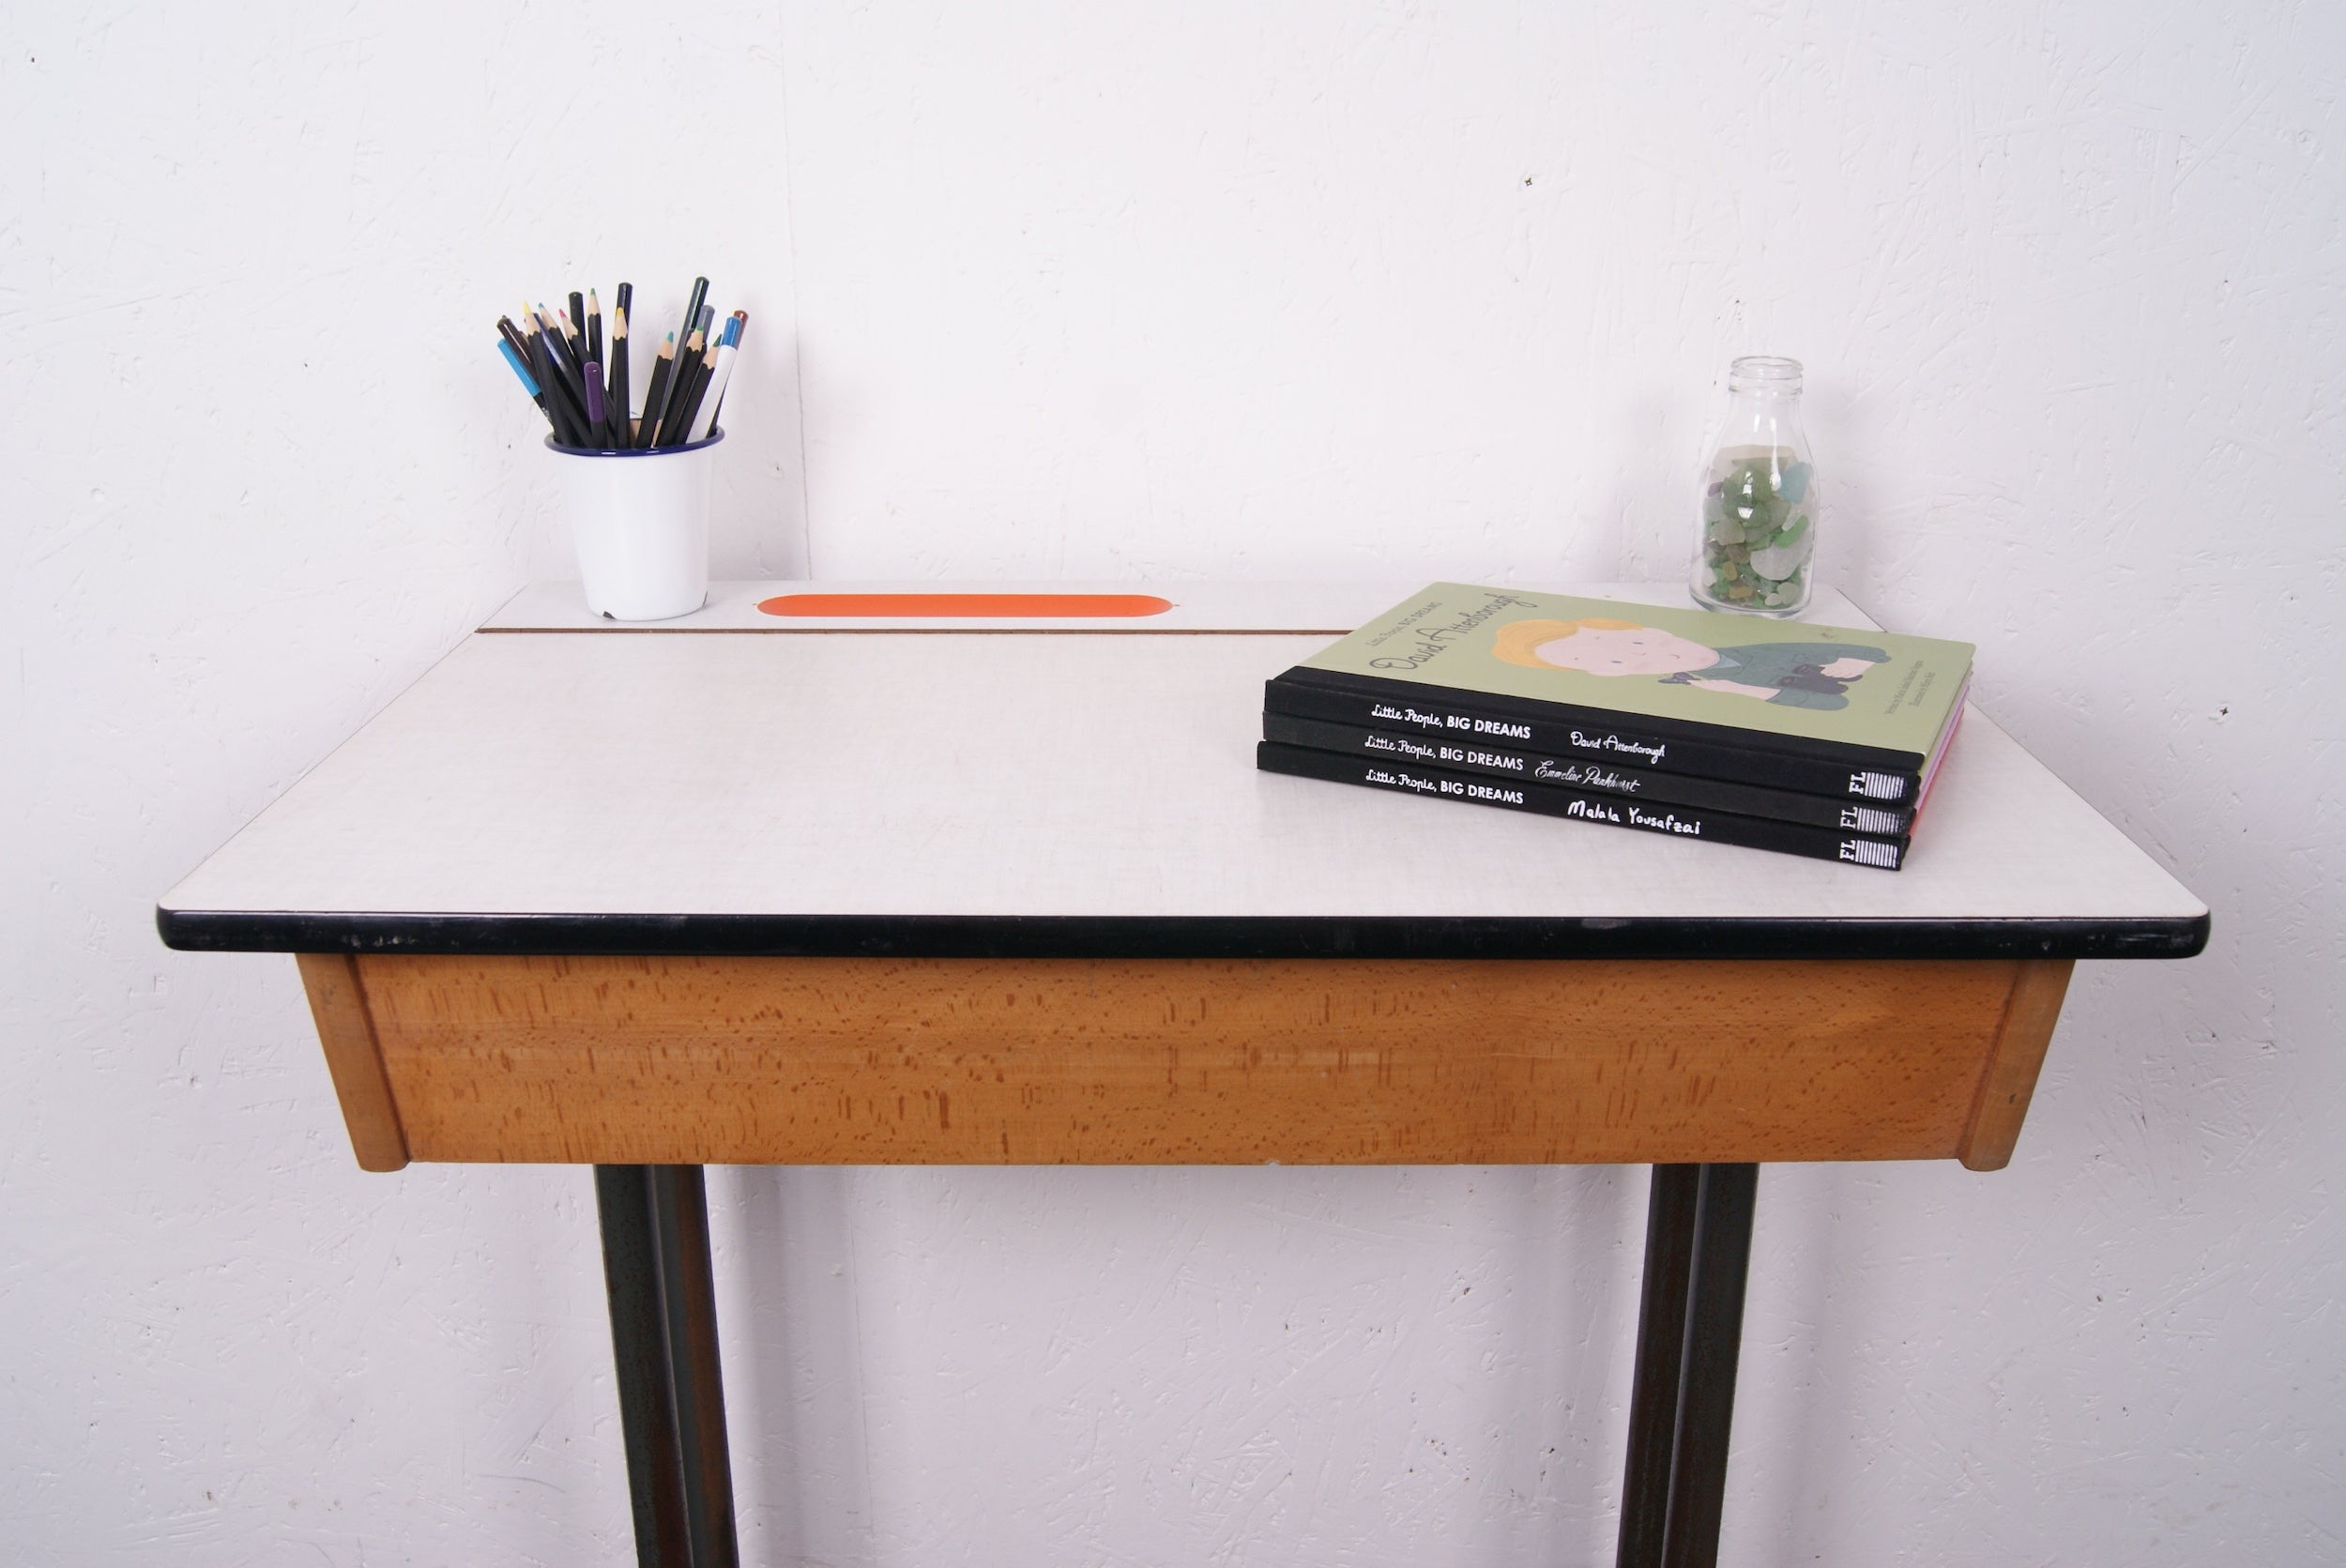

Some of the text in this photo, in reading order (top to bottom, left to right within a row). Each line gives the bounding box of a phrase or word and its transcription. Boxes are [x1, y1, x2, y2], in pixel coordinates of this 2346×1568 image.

[1369, 592, 1538, 670] David Attenborough
[1371, 704, 1531, 739] Little People, BIG DREAMS
[1364, 735, 1524, 771] Little People, BIG DREAMS
[1570, 731, 1666, 765] David Attenborough
[1365, 769, 1524, 804] Little People, BIG DREAMS
[1534, 759, 1582, 782] Emmeline
[1848, 771, 1866, 795] FL
[1568, 799, 1701, 835] Malala Yousafzai
[1840, 806, 1859, 829] FL
[1839, 839, 1856, 860] FL
